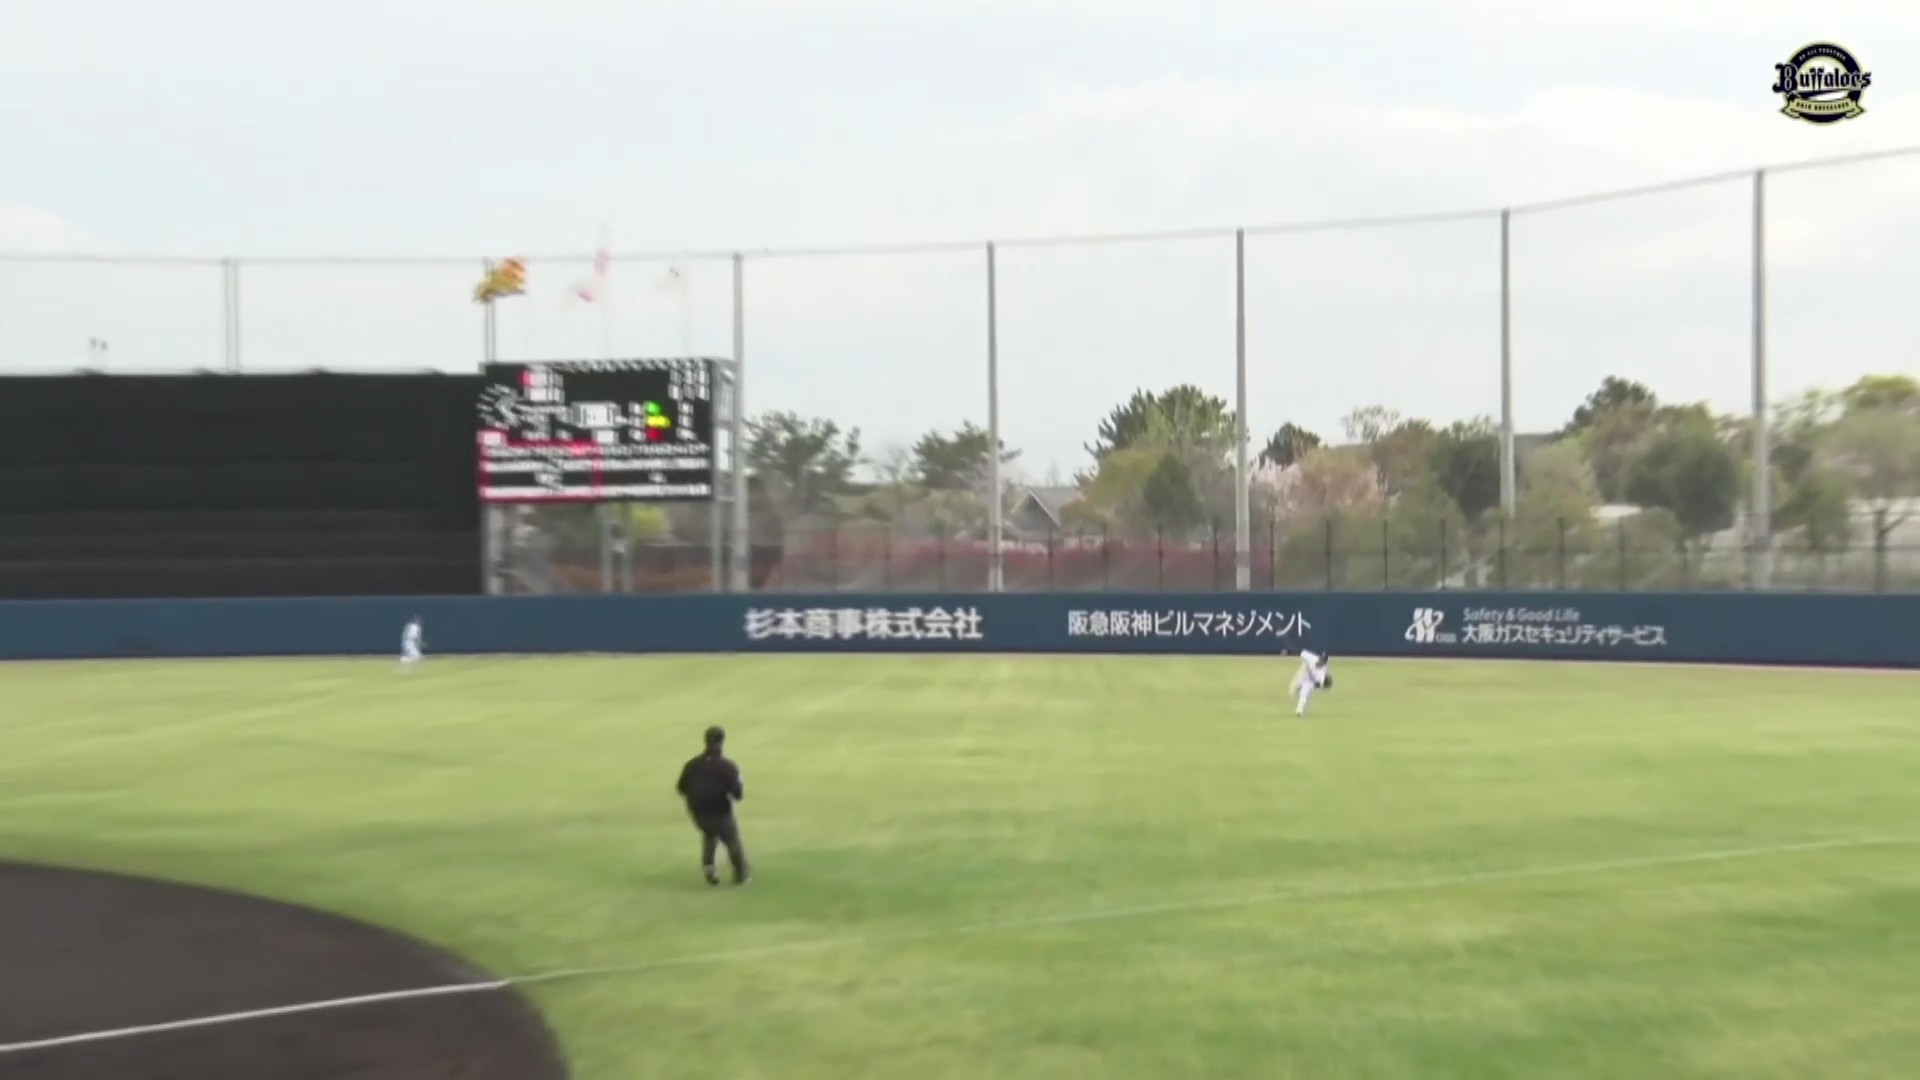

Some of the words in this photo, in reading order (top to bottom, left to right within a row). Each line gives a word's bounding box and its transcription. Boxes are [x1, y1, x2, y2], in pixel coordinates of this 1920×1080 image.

[745, 607, 983, 639] 杉本商事株式会社
[1068, 609, 1311, 637] 阪急阪神ビルマネジメント
[1463, 608, 1503, 624] Safety
[1517, 608, 1553, 621] Good
[1555, 608, 1580, 621] Life
[1461, 623, 1667, 645] 大阪ガスセキュリティサービス
